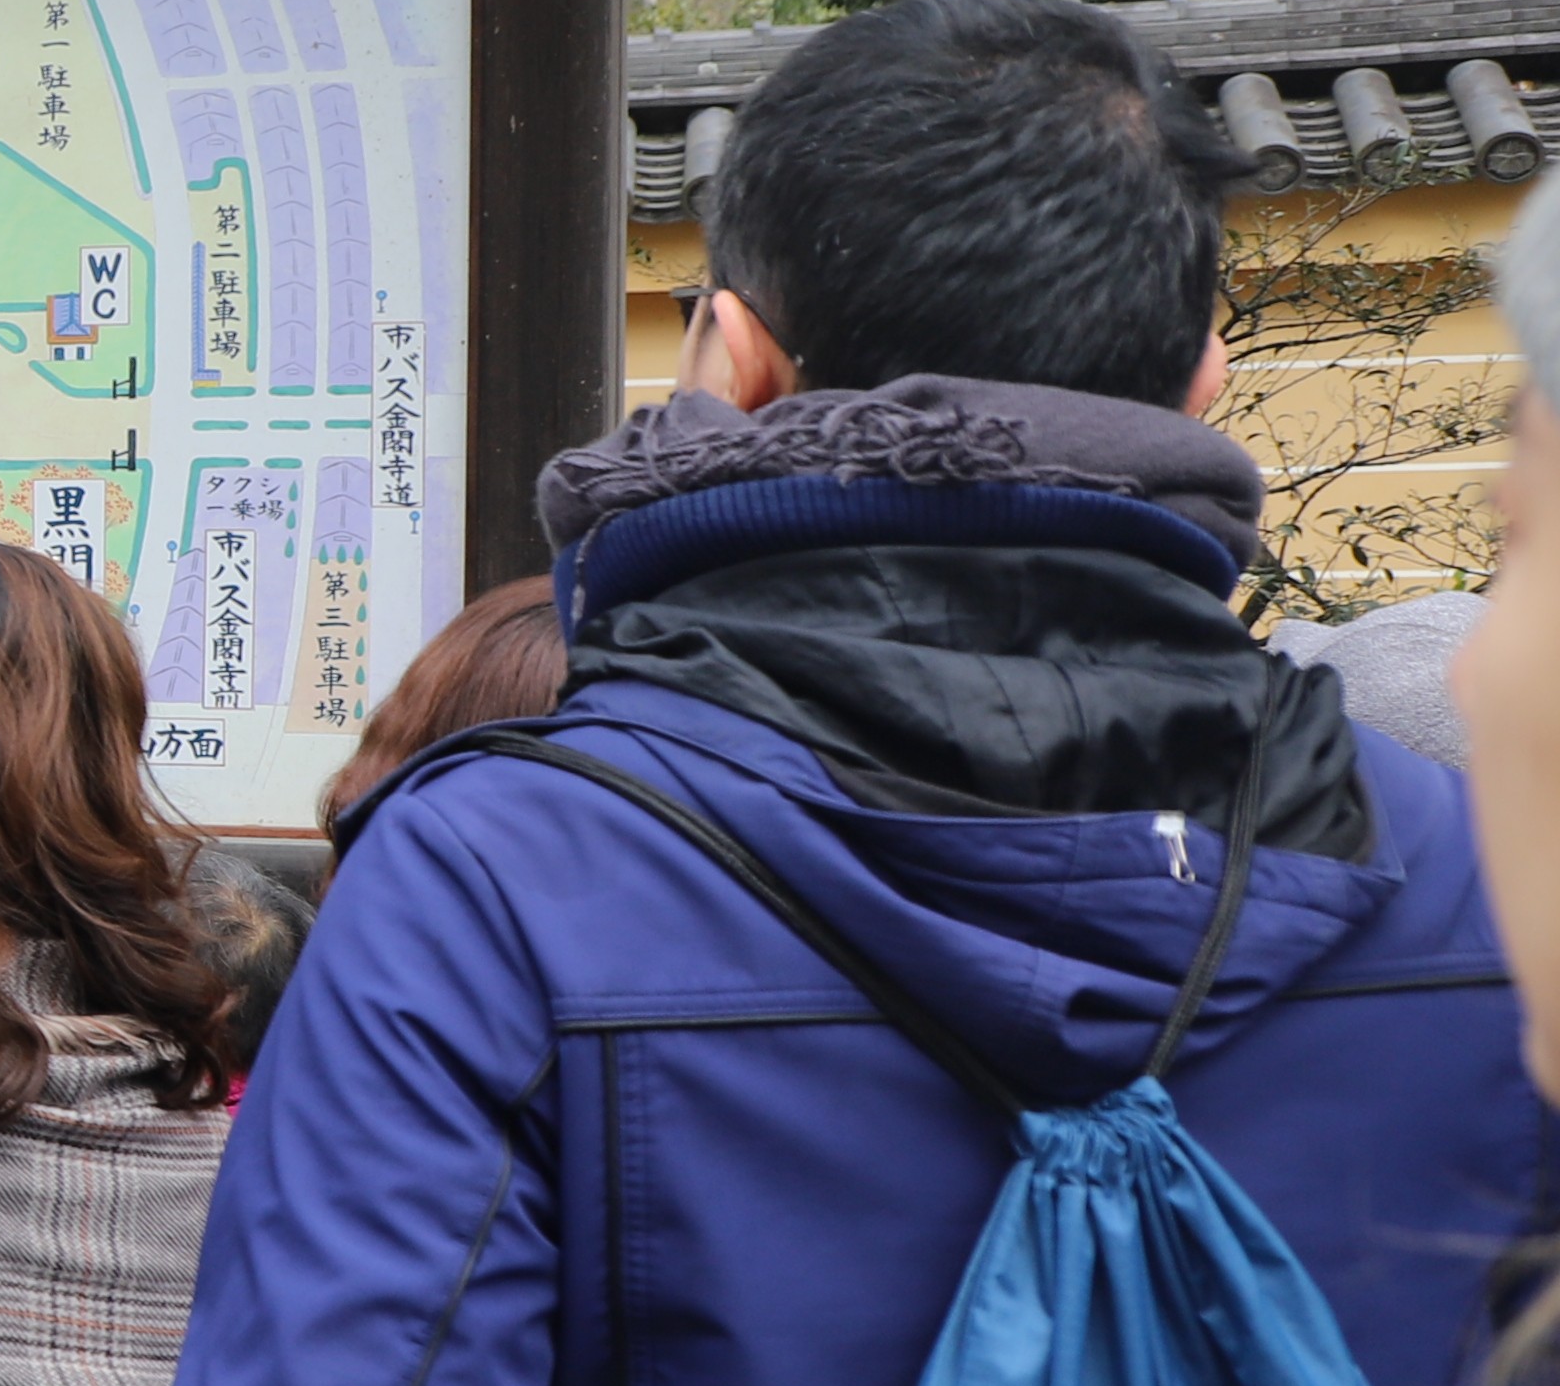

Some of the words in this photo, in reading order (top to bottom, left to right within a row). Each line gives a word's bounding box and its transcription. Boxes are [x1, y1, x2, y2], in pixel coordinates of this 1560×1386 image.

[37, 0, 71, 151] 第一駐車場
[87, 252, 122, 320] WC
[209, 204, 242, 359] 第二駐車場
[379, 324, 421, 506] 市バス金閣寺道
[209, 531, 252, 707] 市バス金閣寺前
[313, 571, 351, 728] 第三駐車場
